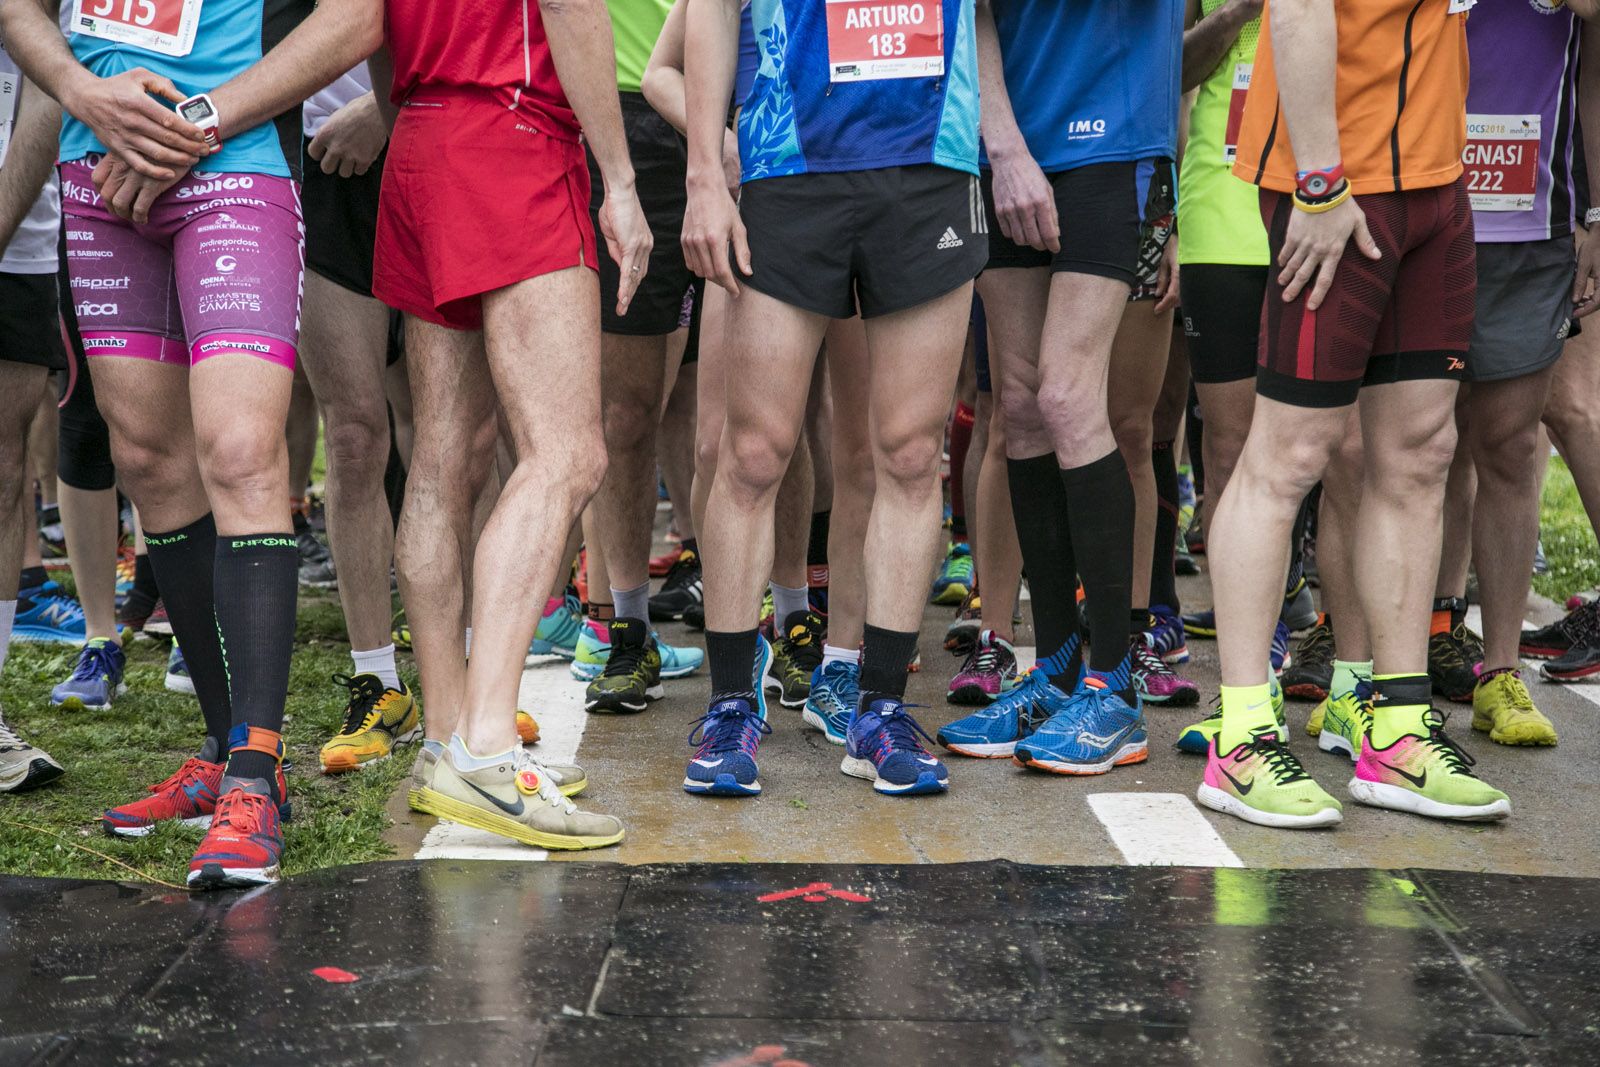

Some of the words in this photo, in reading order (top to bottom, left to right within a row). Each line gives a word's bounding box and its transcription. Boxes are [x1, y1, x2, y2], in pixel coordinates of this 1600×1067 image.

[845, 4, 924, 29] ARTURO
[868, 32, 906, 57] 183
[3, 81, 13, 94] 157
[1068, 119, 1106, 133] IMQ
[1461, 144, 1523, 165] GNASI
[1467, 170, 1504, 191] 222
[936, 239, 964, 250] adidas
[198, 301, 261, 314] CAMATS
